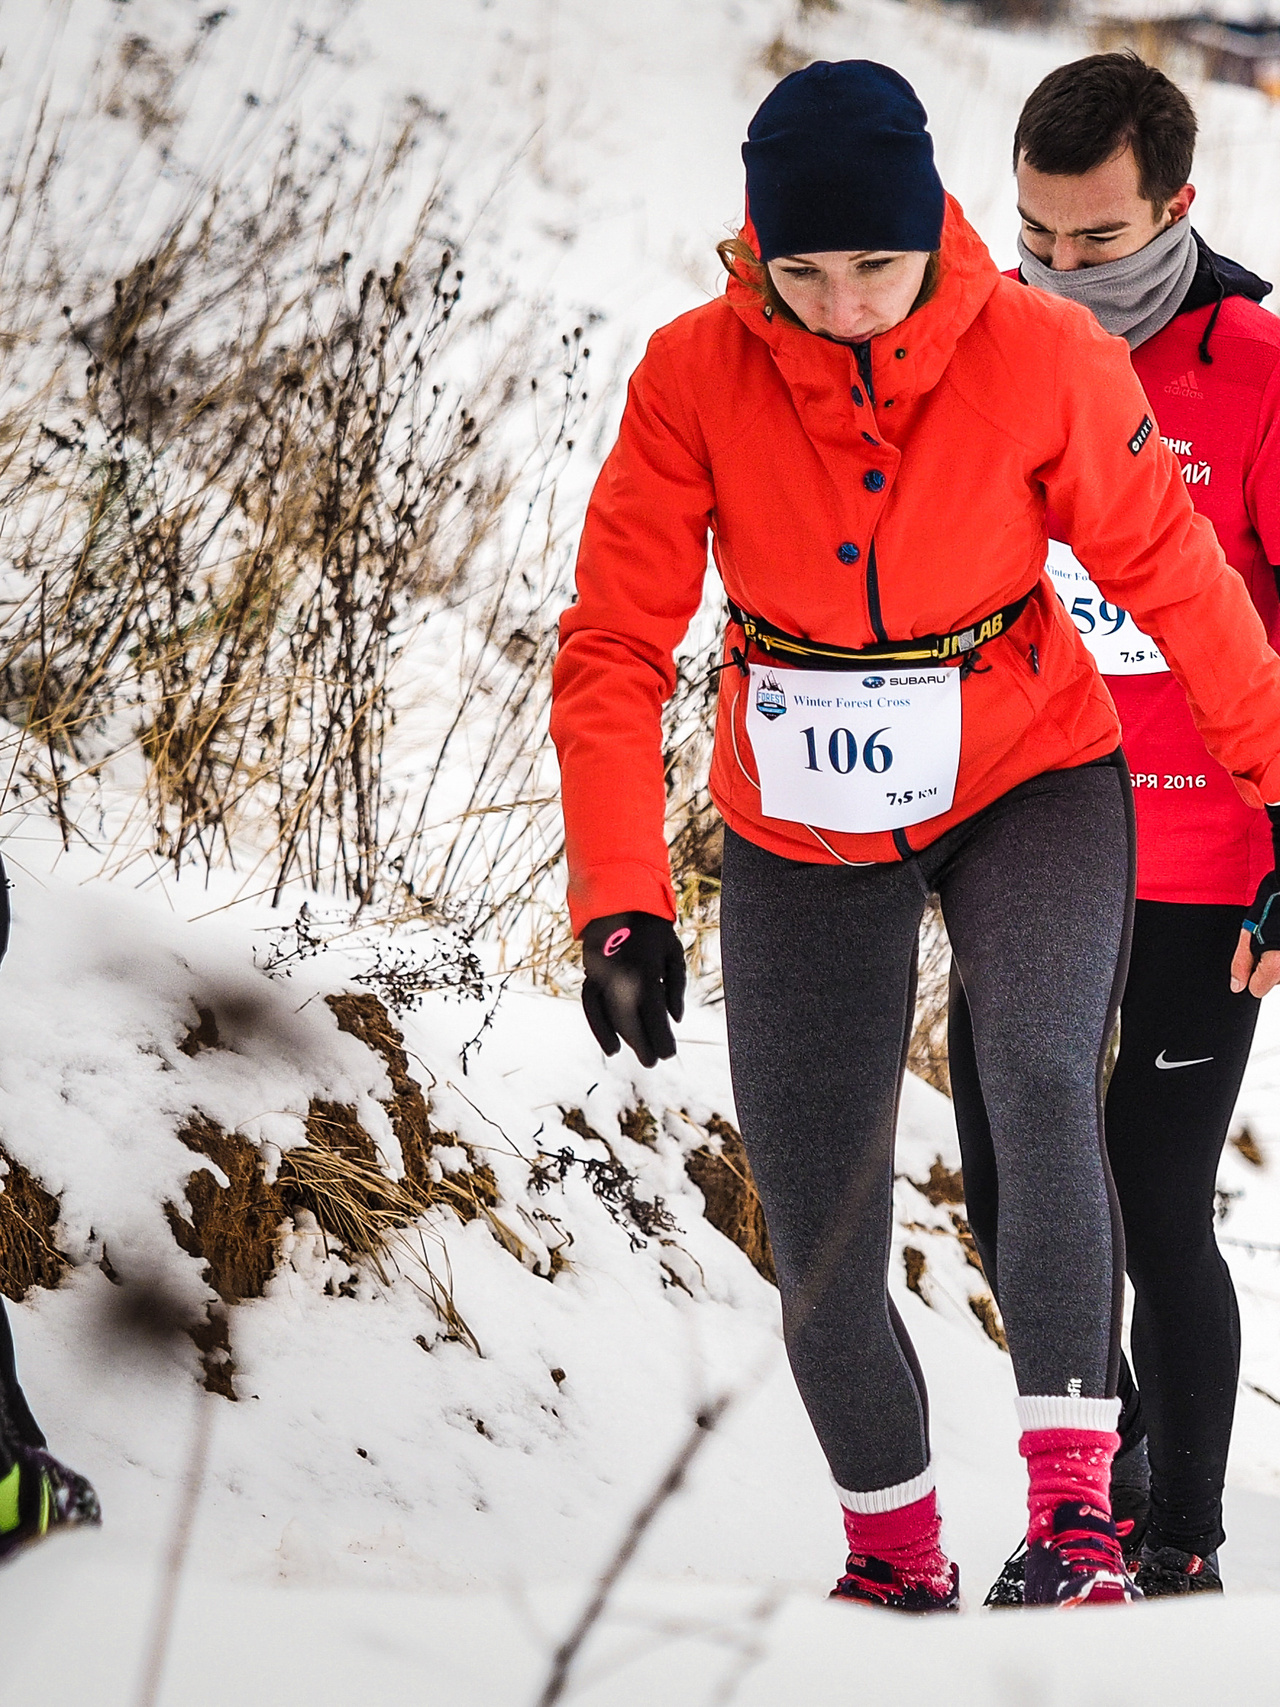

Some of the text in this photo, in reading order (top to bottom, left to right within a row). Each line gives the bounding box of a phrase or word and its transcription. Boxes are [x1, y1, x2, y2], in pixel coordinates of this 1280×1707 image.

[1120, 651, 1145, 663] 7,5
[890, 675, 946, 686] SUBARU
[794, 695, 911, 709] Winter Forest Cross
[800, 726, 893, 775] 106
[1163, 775, 1207, 790] 2016
[886, 791, 913, 806] 7,5
